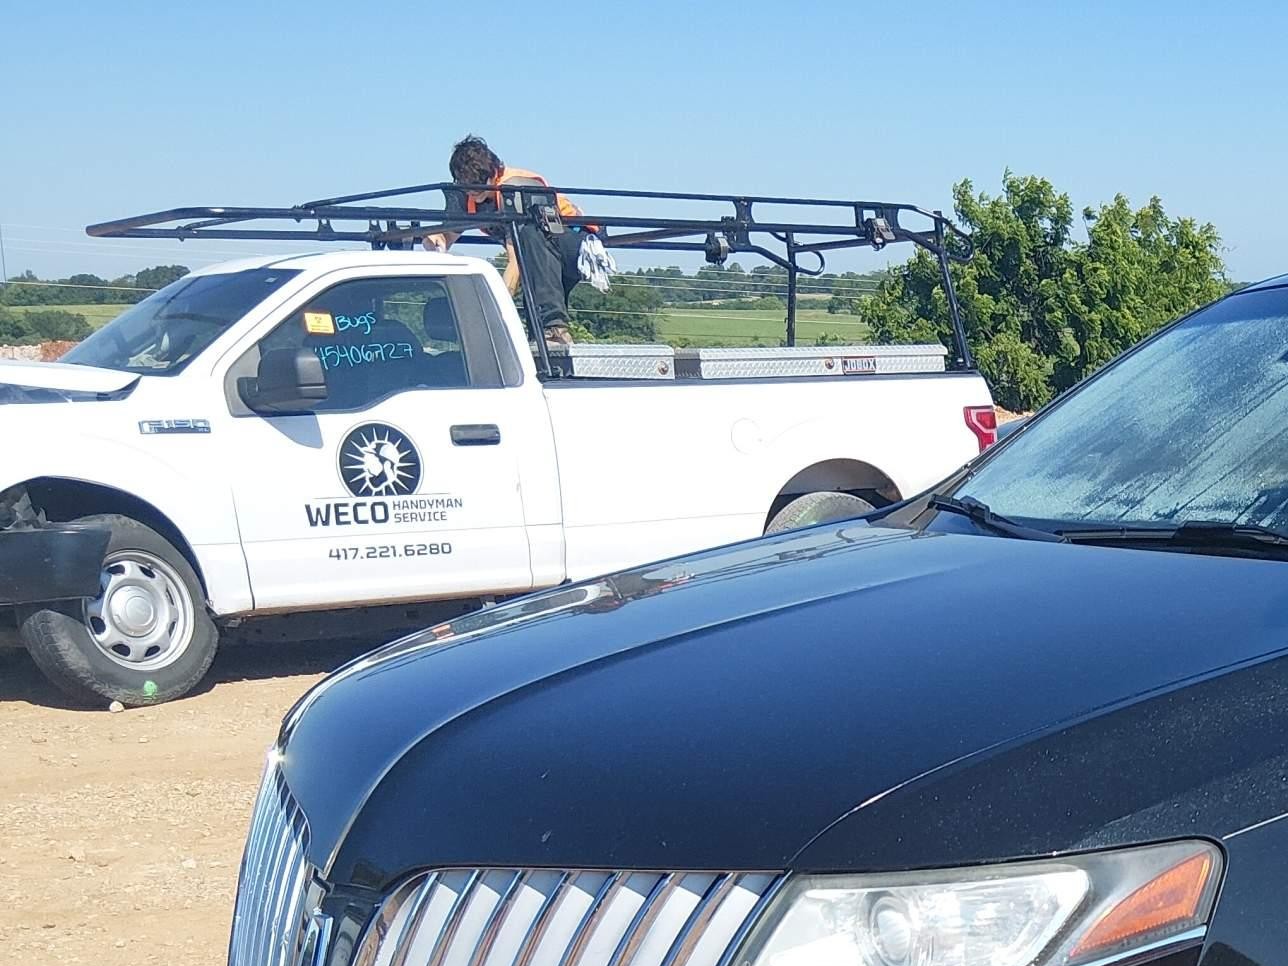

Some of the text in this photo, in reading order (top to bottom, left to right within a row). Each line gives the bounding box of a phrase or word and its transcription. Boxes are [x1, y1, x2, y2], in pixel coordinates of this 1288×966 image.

[335, 312, 376, 335] Bugs
[304, 498, 463, 527] WECO HANDYMAN
[394, 511, 448, 523] SERVICE
[329, 543, 452, 560] 417.221.6280
